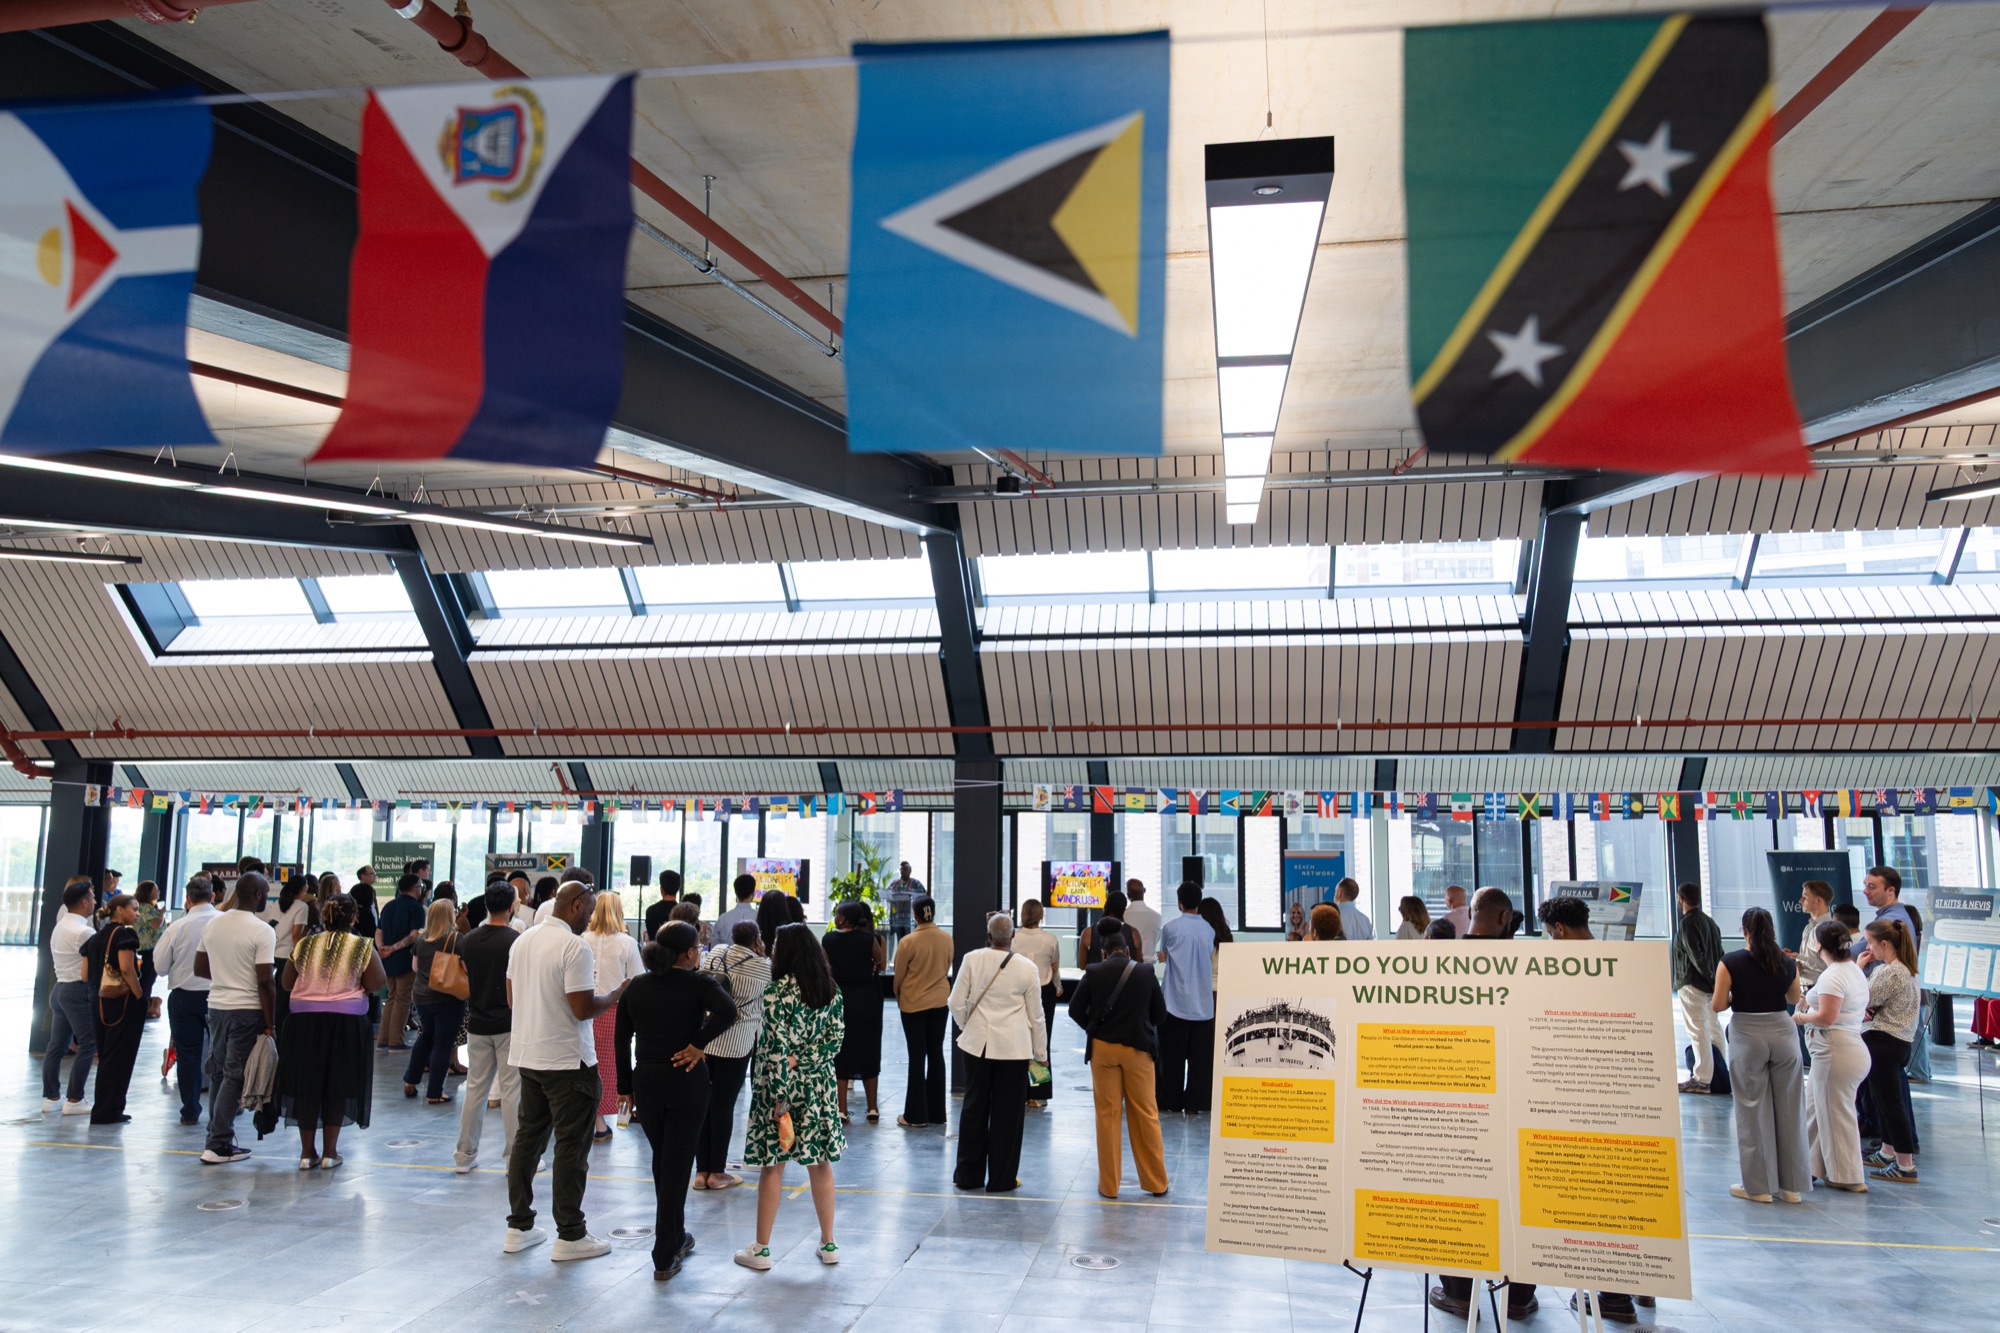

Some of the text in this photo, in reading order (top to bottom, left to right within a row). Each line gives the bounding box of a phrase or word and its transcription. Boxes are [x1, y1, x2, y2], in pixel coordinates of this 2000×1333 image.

[374, 855, 405, 863] Diversity,
[1056, 877, 1101, 888] SOLIDARITY
[1561, 889, 1593, 897] GUYANA
[1056, 894, 1100, 905] WINDRUSH
[1943, 899, 1961, 908] KITTS
[1968, 900, 1991, 910] NEVIS
[1262, 956, 1618, 977] WHAT DO YOU KNOW ABOUT
[1352, 985, 1510, 1006] WINDRUSH?
[1254, 1056, 1272, 1064] EMPIRE
[1548, 1134, 1577, 1142] happened
[1614, 1180, 1668, 1190] recommendations
[1434, 1199, 1463, 1208] generation
[1552, 1209, 1585, 1218] government
[1627, 1215, 1656, 1223] Windrush
[1553, 1217, 1596, 1228] Compensation
[1531, 1243, 1551, 1251] Empire
[1552, 1244, 1578, 1253] Windrush
[1531, 1260, 1557, 1269] originally
[1606, 1267, 1618, 1275] ship
[1640, 1270, 1667, 1279] travellers
